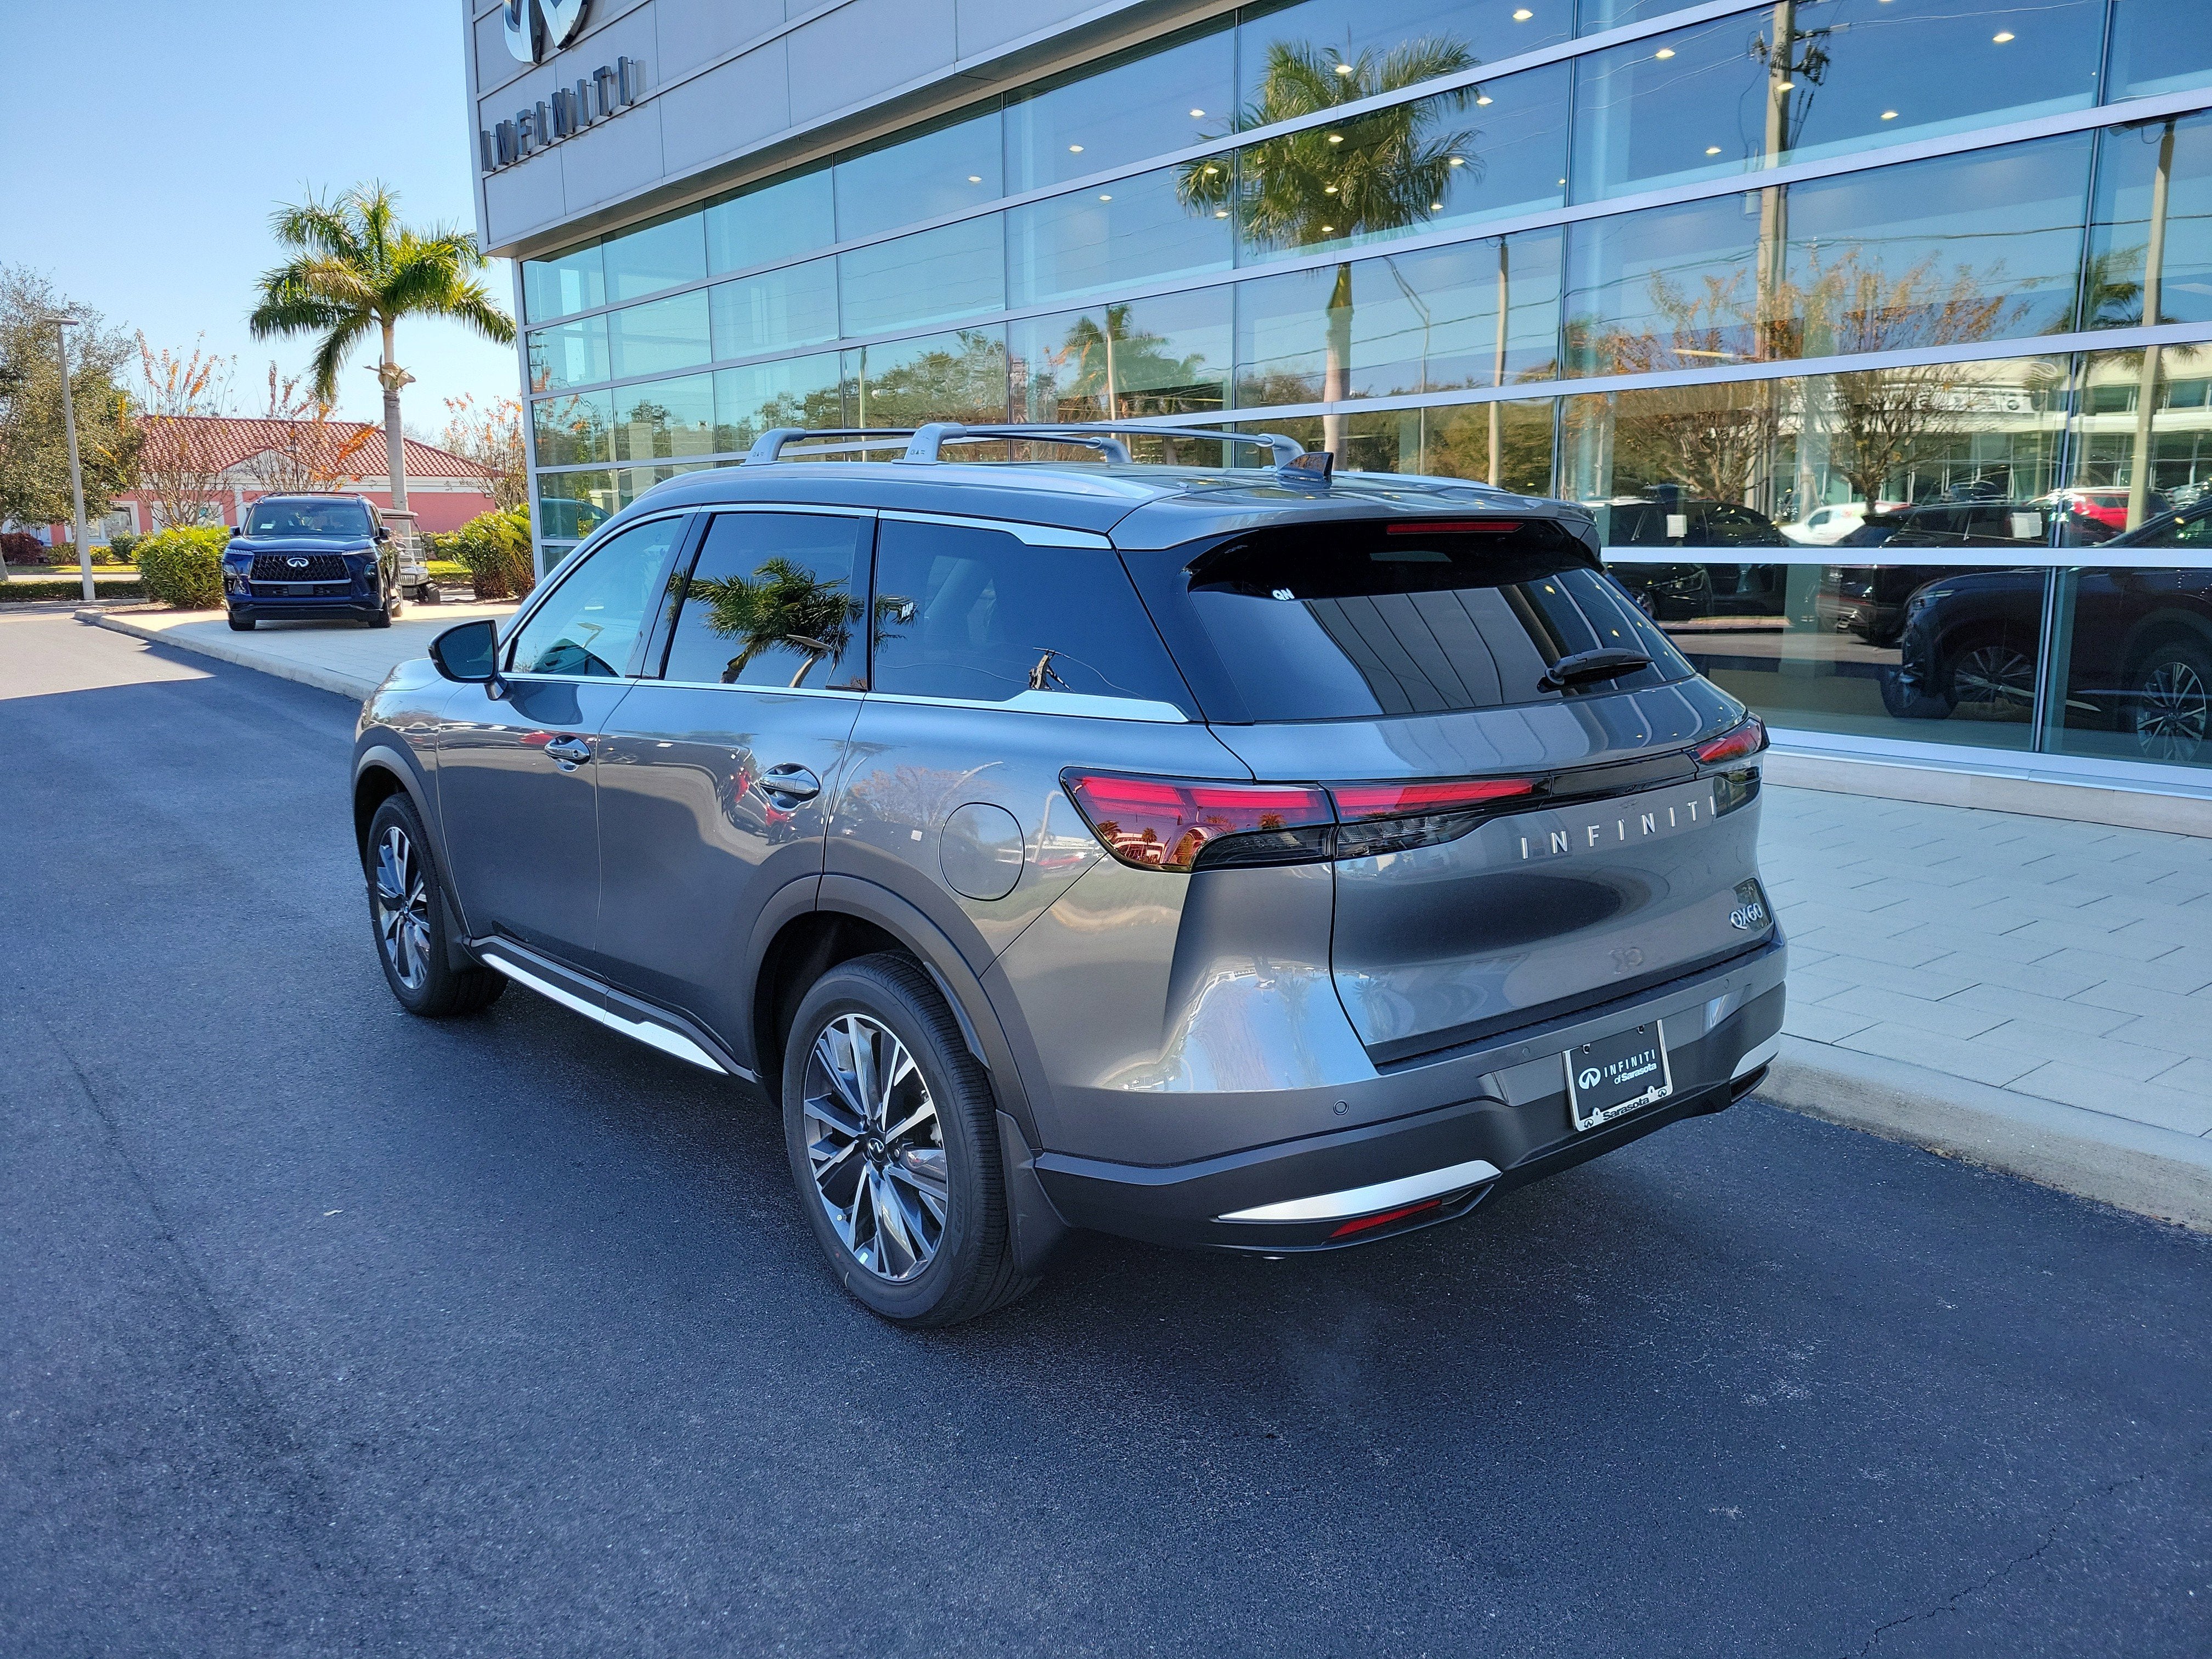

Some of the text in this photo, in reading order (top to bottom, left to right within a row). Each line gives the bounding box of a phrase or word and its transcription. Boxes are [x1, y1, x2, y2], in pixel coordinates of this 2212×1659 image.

[482, 56, 631, 172] INFINITI
[1521, 795, 1716, 860] INFINITI
[1730, 902, 1763, 929] QX60
[1604, 1049, 1656, 1078] INFINITI
[1613, 1063, 1657, 1085] of Sarasota
[1602, 1097, 1650, 1121] Sarasota
